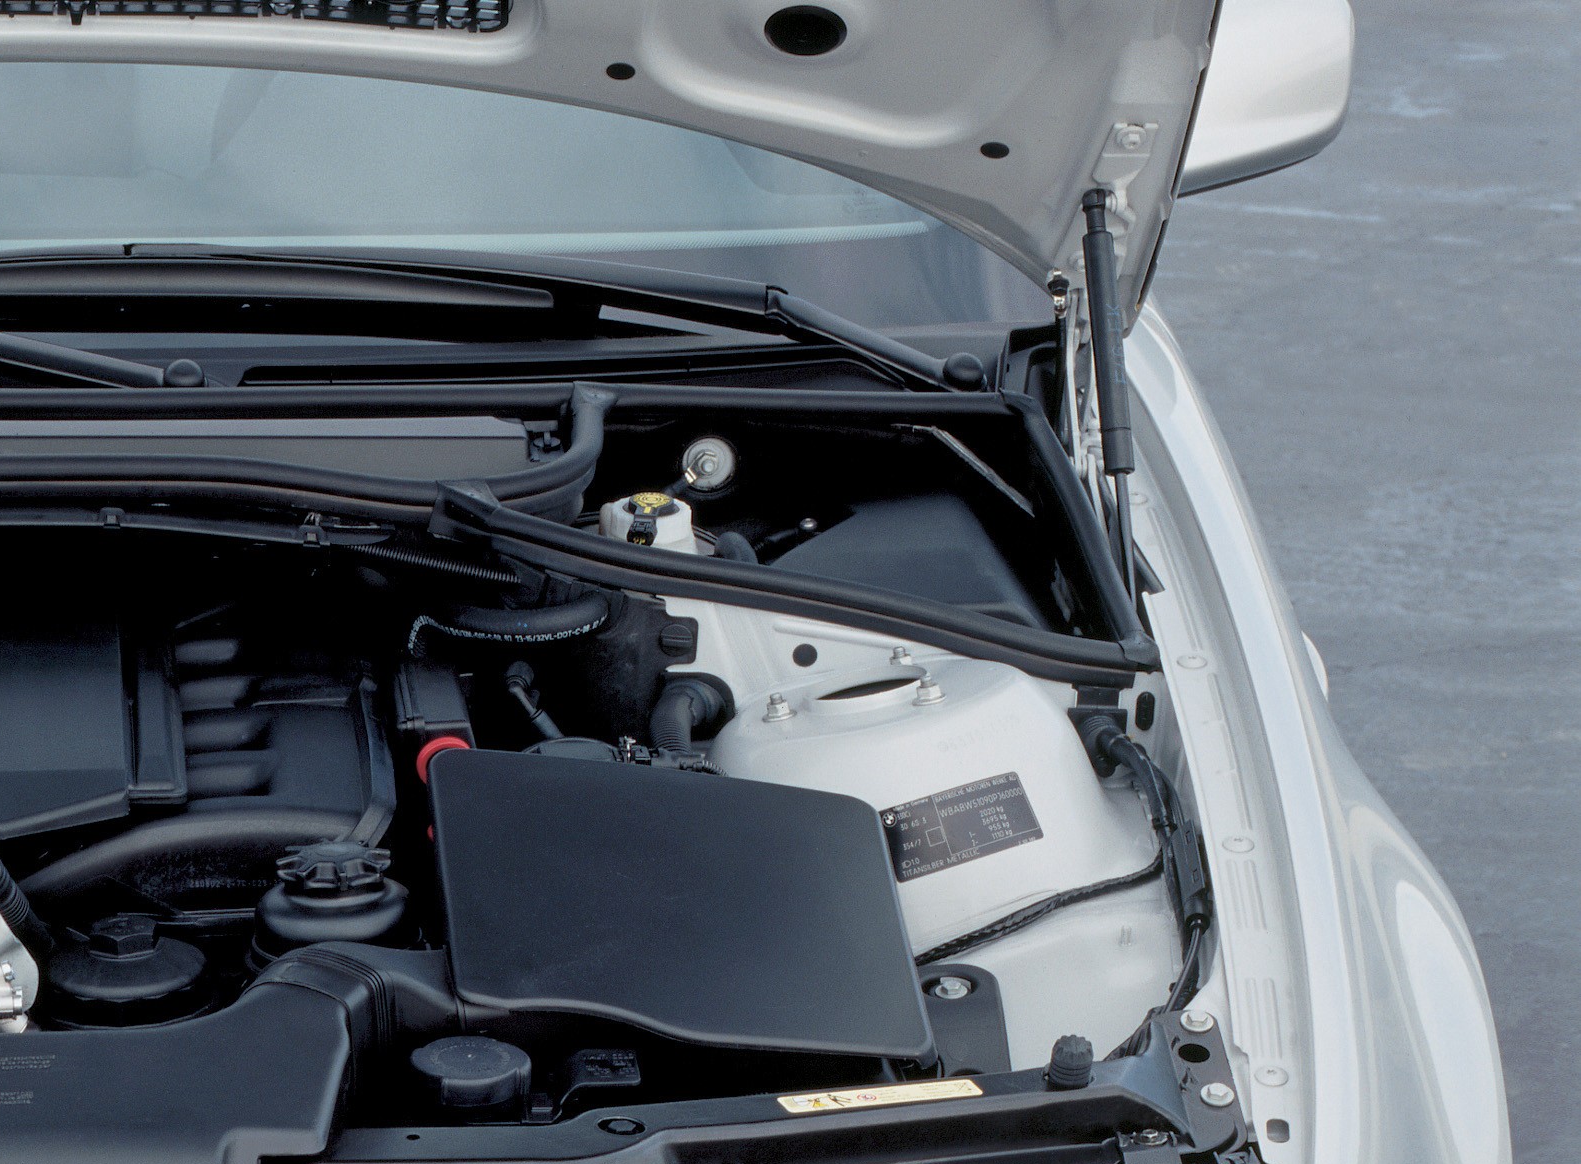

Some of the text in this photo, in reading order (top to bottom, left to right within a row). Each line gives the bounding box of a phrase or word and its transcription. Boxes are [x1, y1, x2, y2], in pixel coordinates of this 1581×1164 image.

[966, 782, 990, 793] MOTOREN
[980, 807, 996, 817] 2020
[988, 823, 1001, 831] 955
[992, 831, 1004, 839] 1110
[1005, 829, 1012, 837] kg
